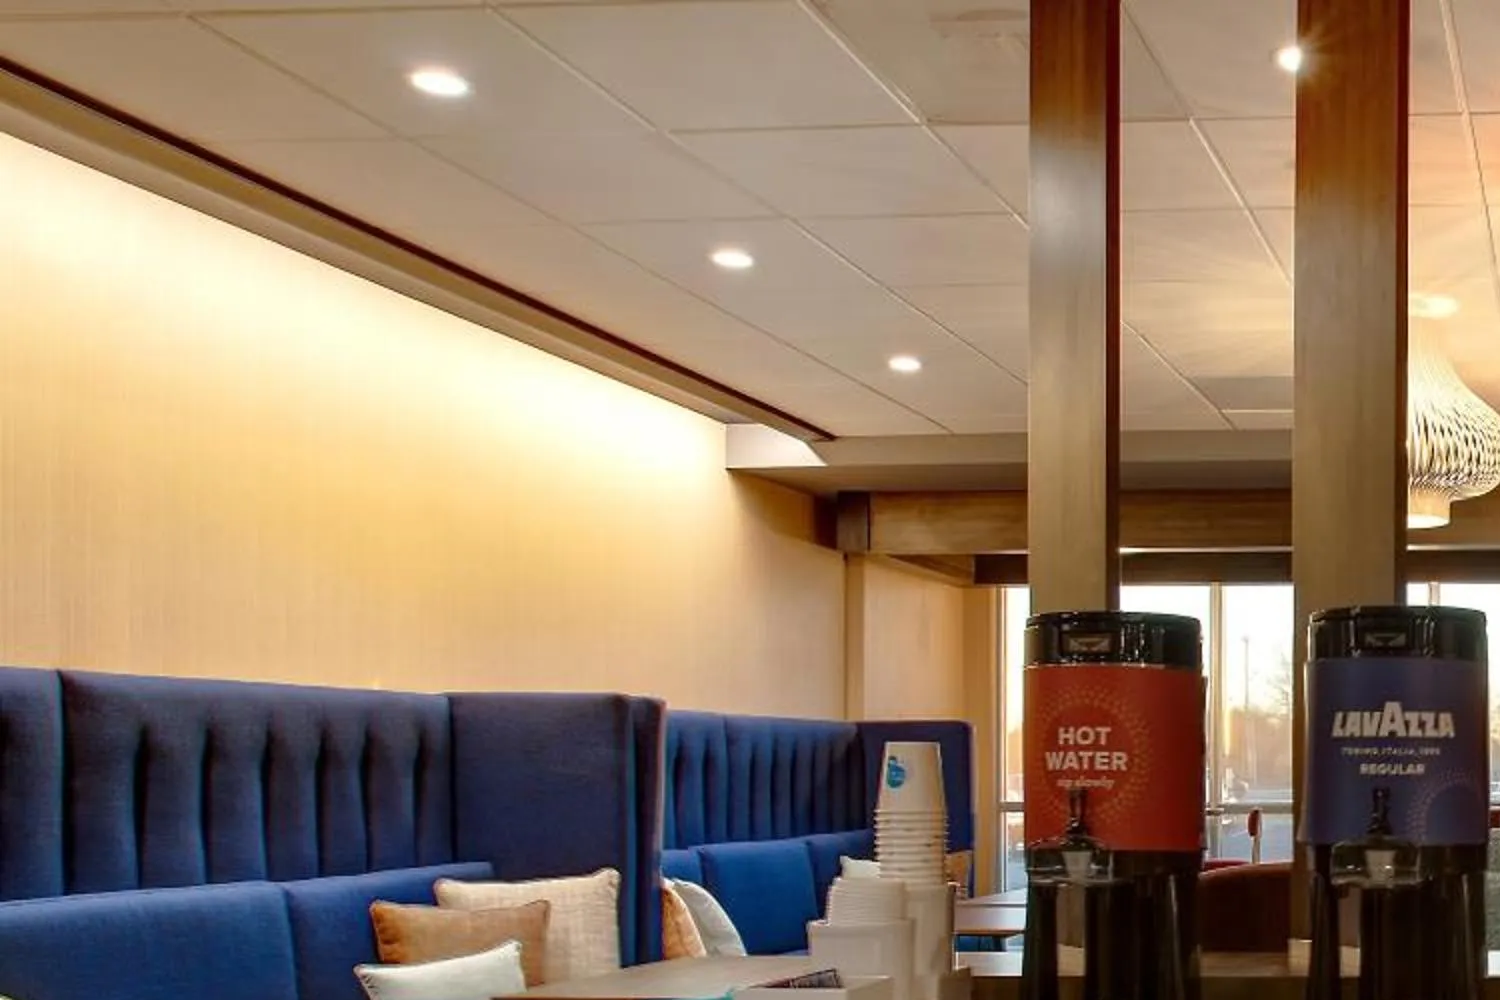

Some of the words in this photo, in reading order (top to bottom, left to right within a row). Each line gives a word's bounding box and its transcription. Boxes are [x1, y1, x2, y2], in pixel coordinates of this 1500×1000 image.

[1332, 701, 1455, 738] LAVAZZA
[1058, 726, 1112, 745] HOT
[1045, 751, 1127, 770] WATER
[1360, 763, 1425, 775] REGULAR
